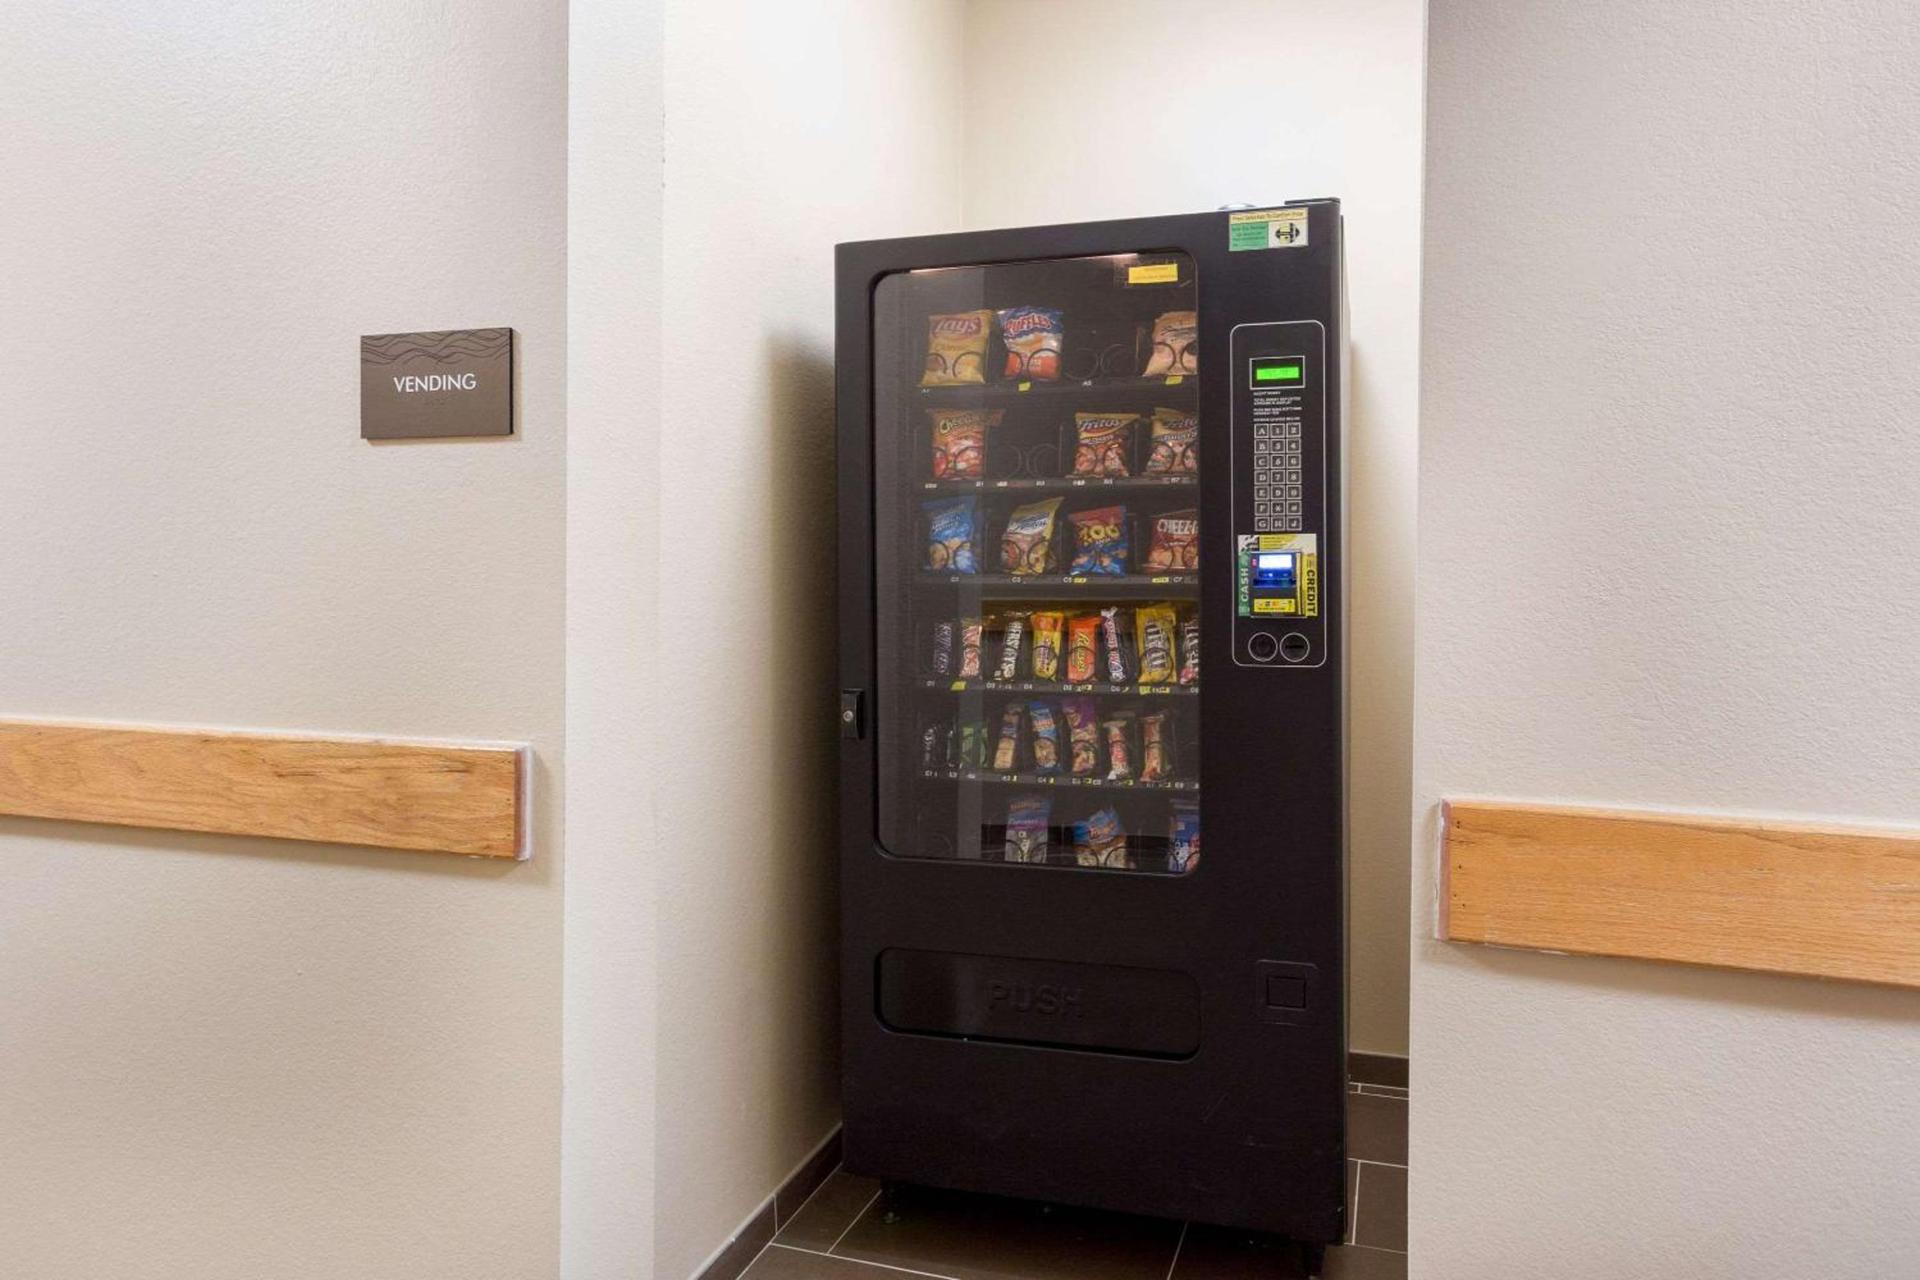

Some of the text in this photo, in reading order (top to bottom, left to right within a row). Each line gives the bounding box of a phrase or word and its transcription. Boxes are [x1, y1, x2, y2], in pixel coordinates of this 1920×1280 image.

[393, 373, 477, 392] VENDING
[1241, 568, 1249, 602] CASH
[1306, 569, 1315, 613] CREDIT
